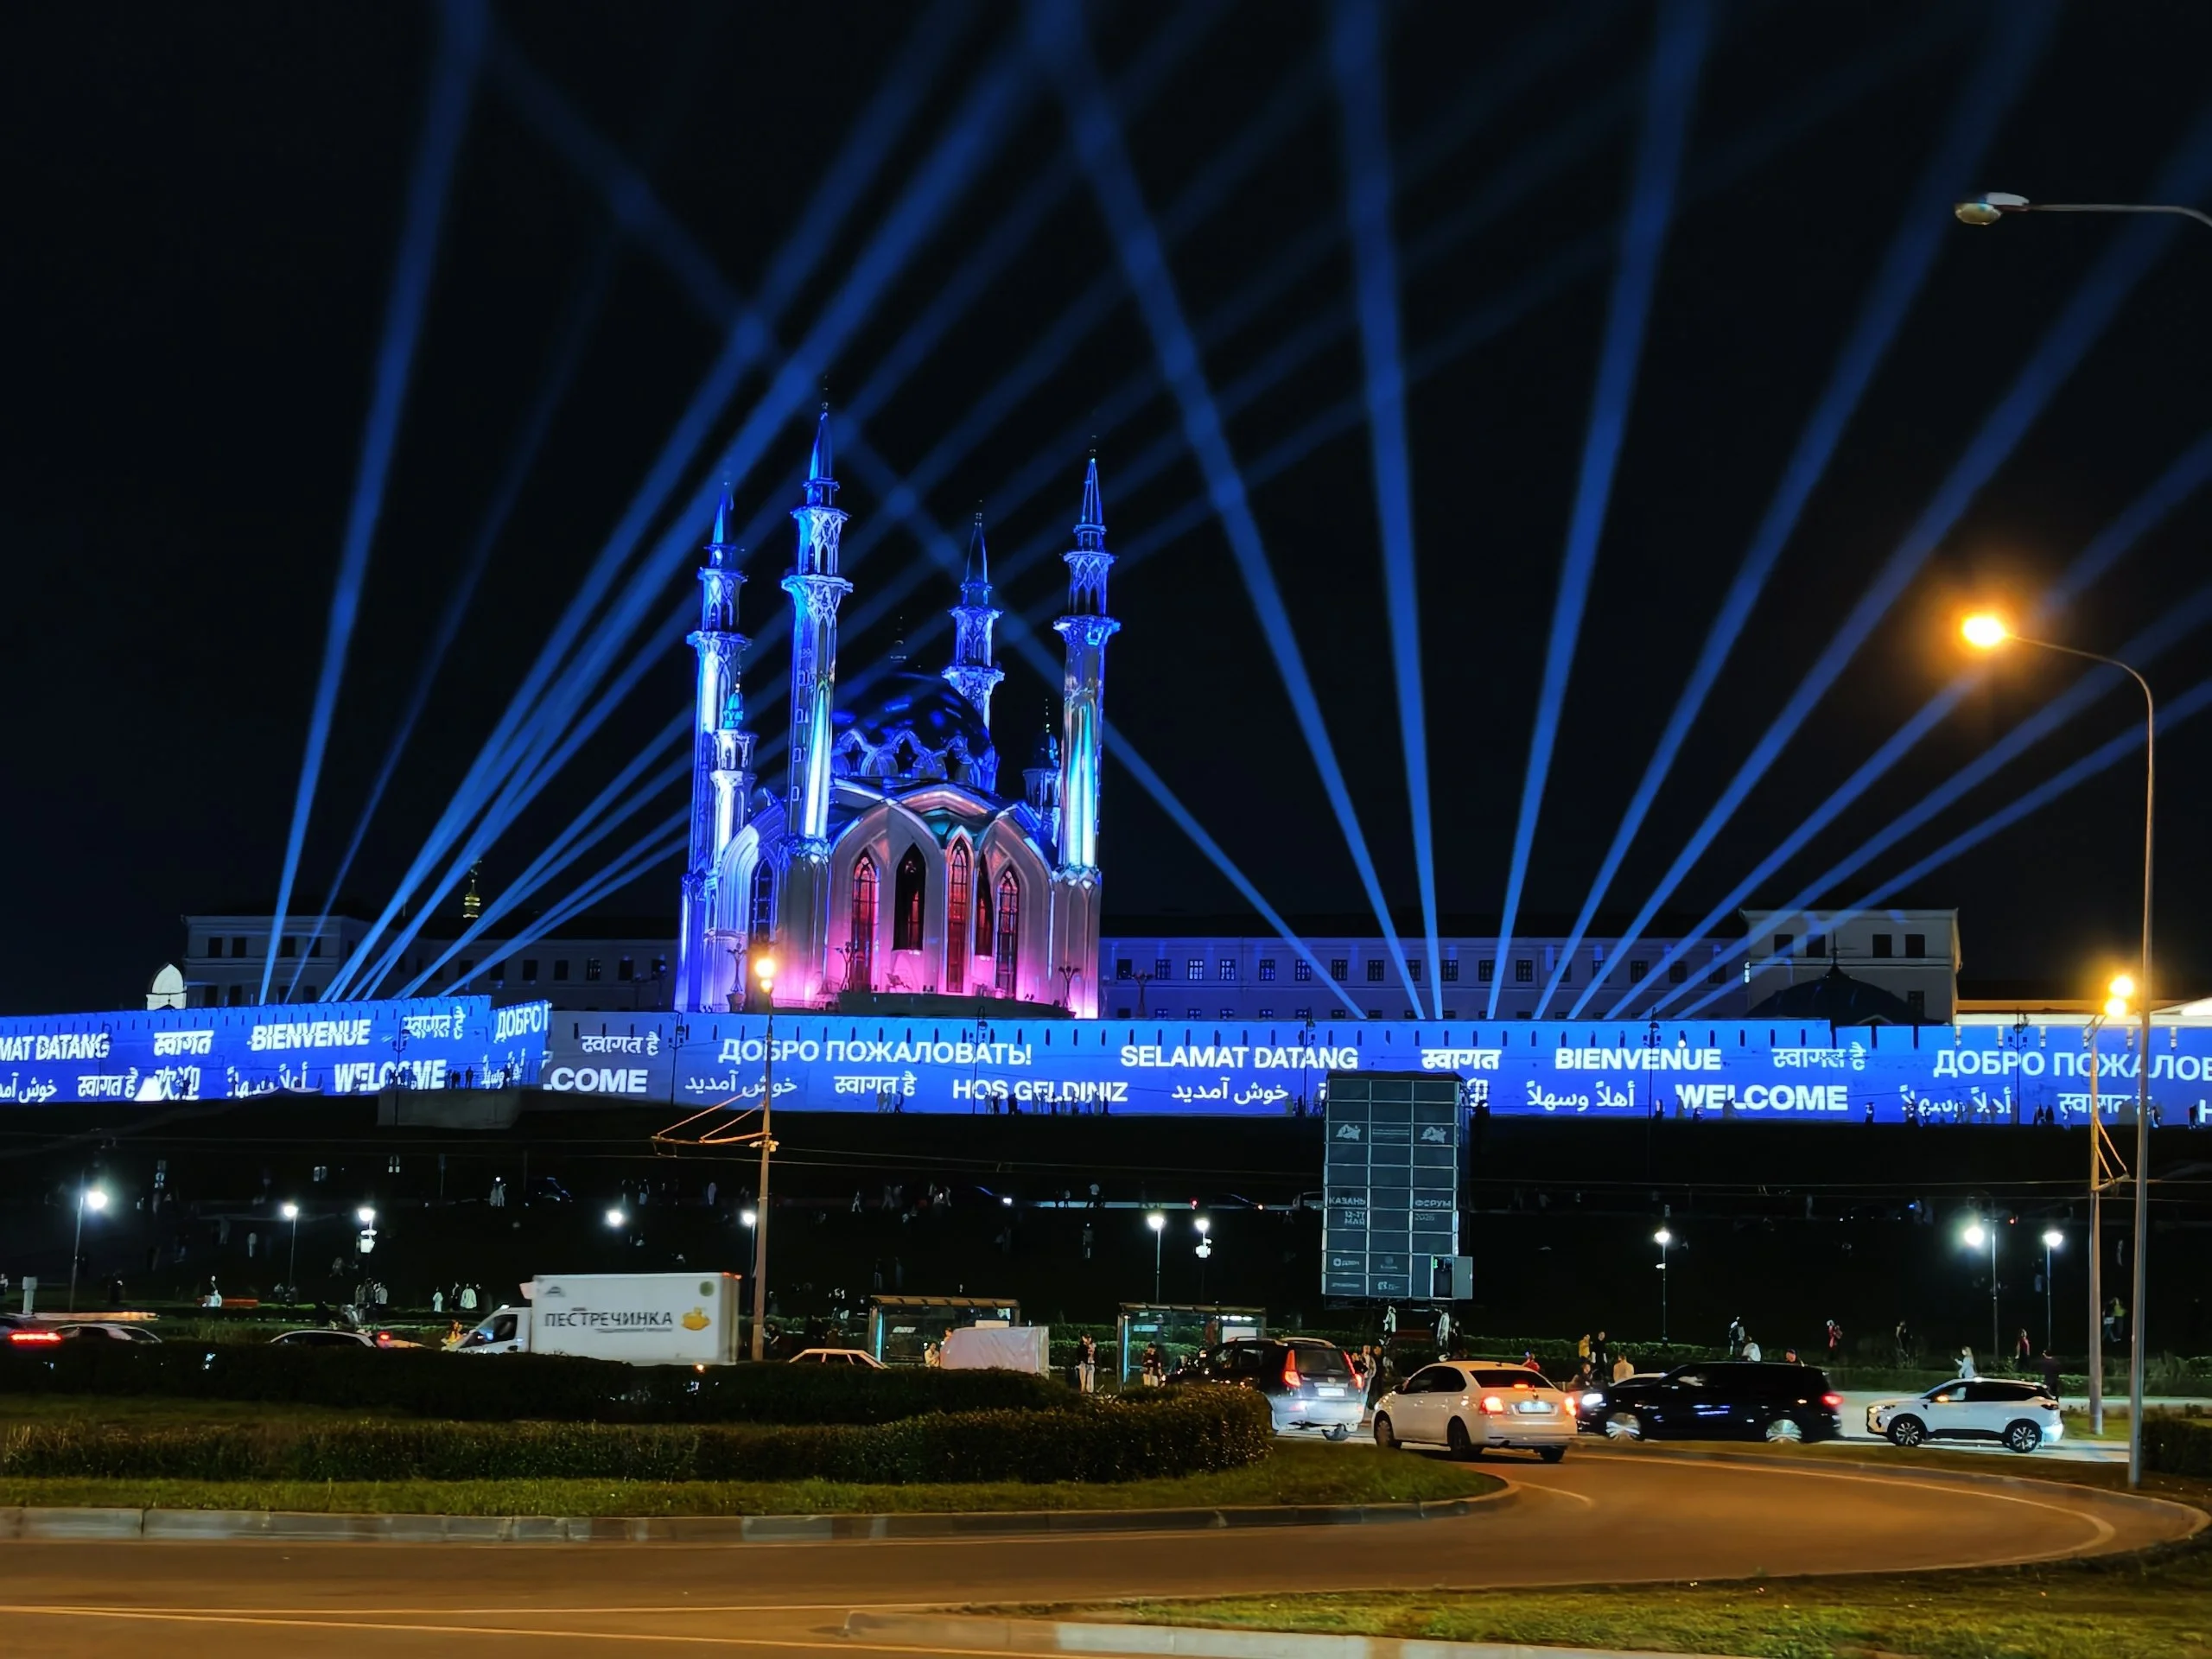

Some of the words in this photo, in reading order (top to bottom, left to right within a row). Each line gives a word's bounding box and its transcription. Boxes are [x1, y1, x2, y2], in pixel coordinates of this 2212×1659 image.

[249, 1020, 372, 1052] BIENVENUE
[493, 1005, 542, 1044] ДОБРО
[35, 1033, 110, 1061] DATANG
[153, 1030, 214, 1057] स्वागत
[581, 1035, 644, 1054] स्वागत
[645, 1031, 660, 1056] है
[718, 1038, 819, 1065] ДОБРО
[825, 1040, 1032, 1065] ПОЖАЛОВАТЬ!
[1120, 1045, 1250, 1069] SELAMAT
[1254, 1046, 1358, 1070] DATANG
[1421, 1048, 1503, 1070] स्वागत
[1554, 1047, 1722, 1071] BIENVENUE
[1771, 1048, 1847, 1068] स्वागत
[1933, 1050, 2045, 1077] ДОБРО
[77, 1075, 124, 1097] स्वागत
[833, 1076, 899, 1094] स्वागत
[1675, 1084, 1848, 1111] WELCOME
[1328, 1197, 1366, 1205] КАЗАНЬ
[544, 1312, 673, 1327] ПЕСТРЕЧИНКА
